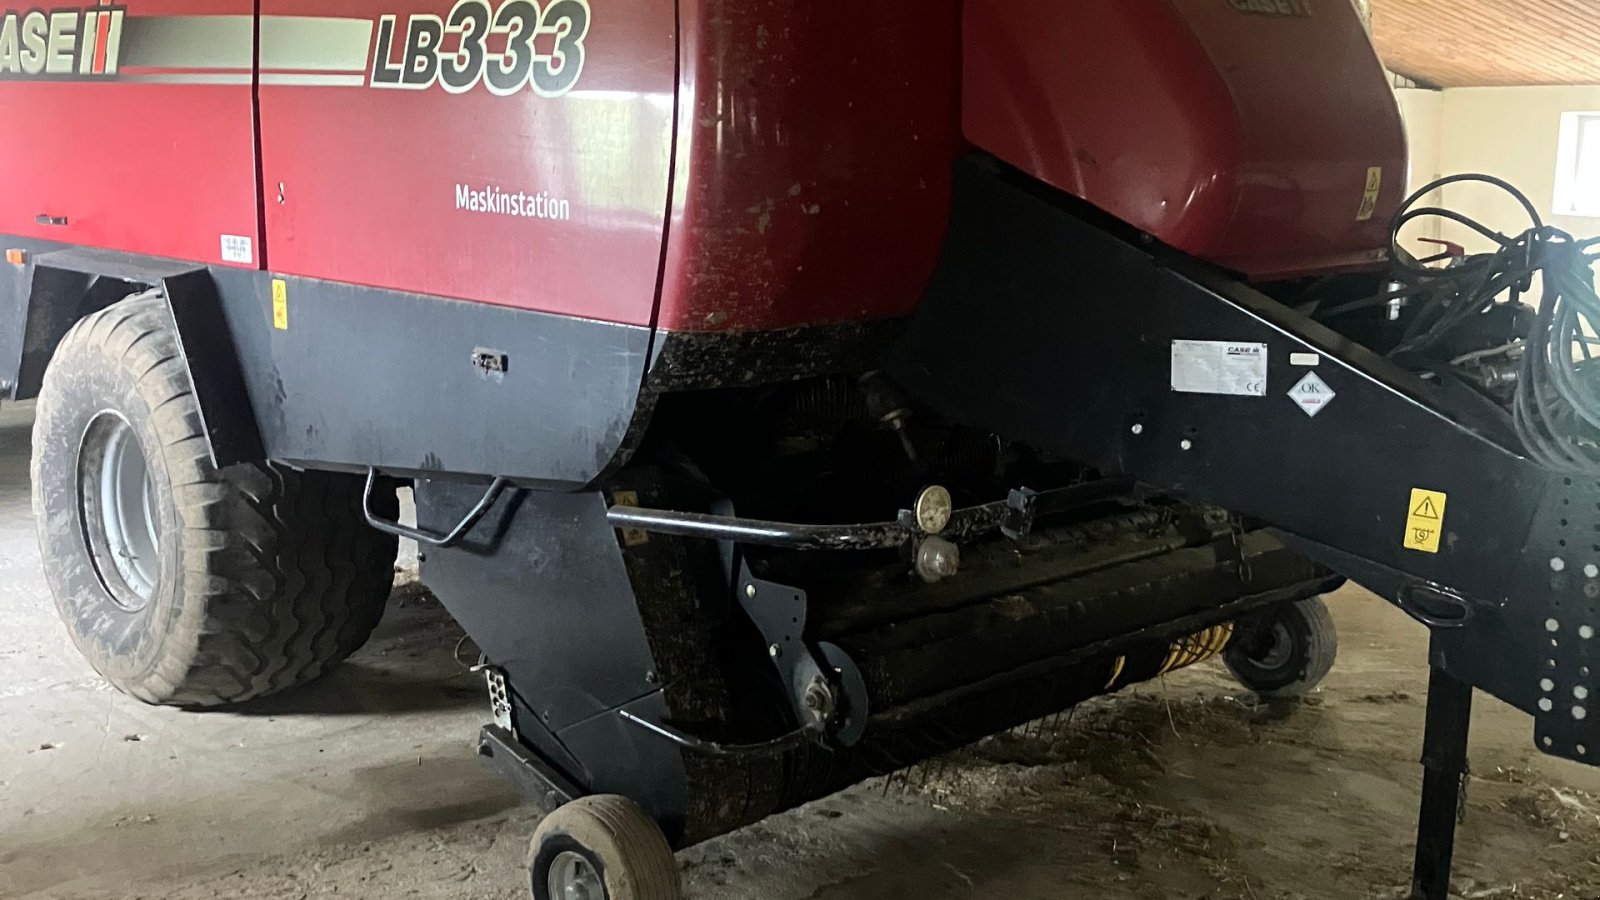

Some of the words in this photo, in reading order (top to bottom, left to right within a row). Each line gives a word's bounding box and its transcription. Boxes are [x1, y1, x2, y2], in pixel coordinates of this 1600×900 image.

[370, 0, 591, 98] LB333
[455, 183, 570, 221] Maskinstation
[1301, 383, 1320, 394] OK
